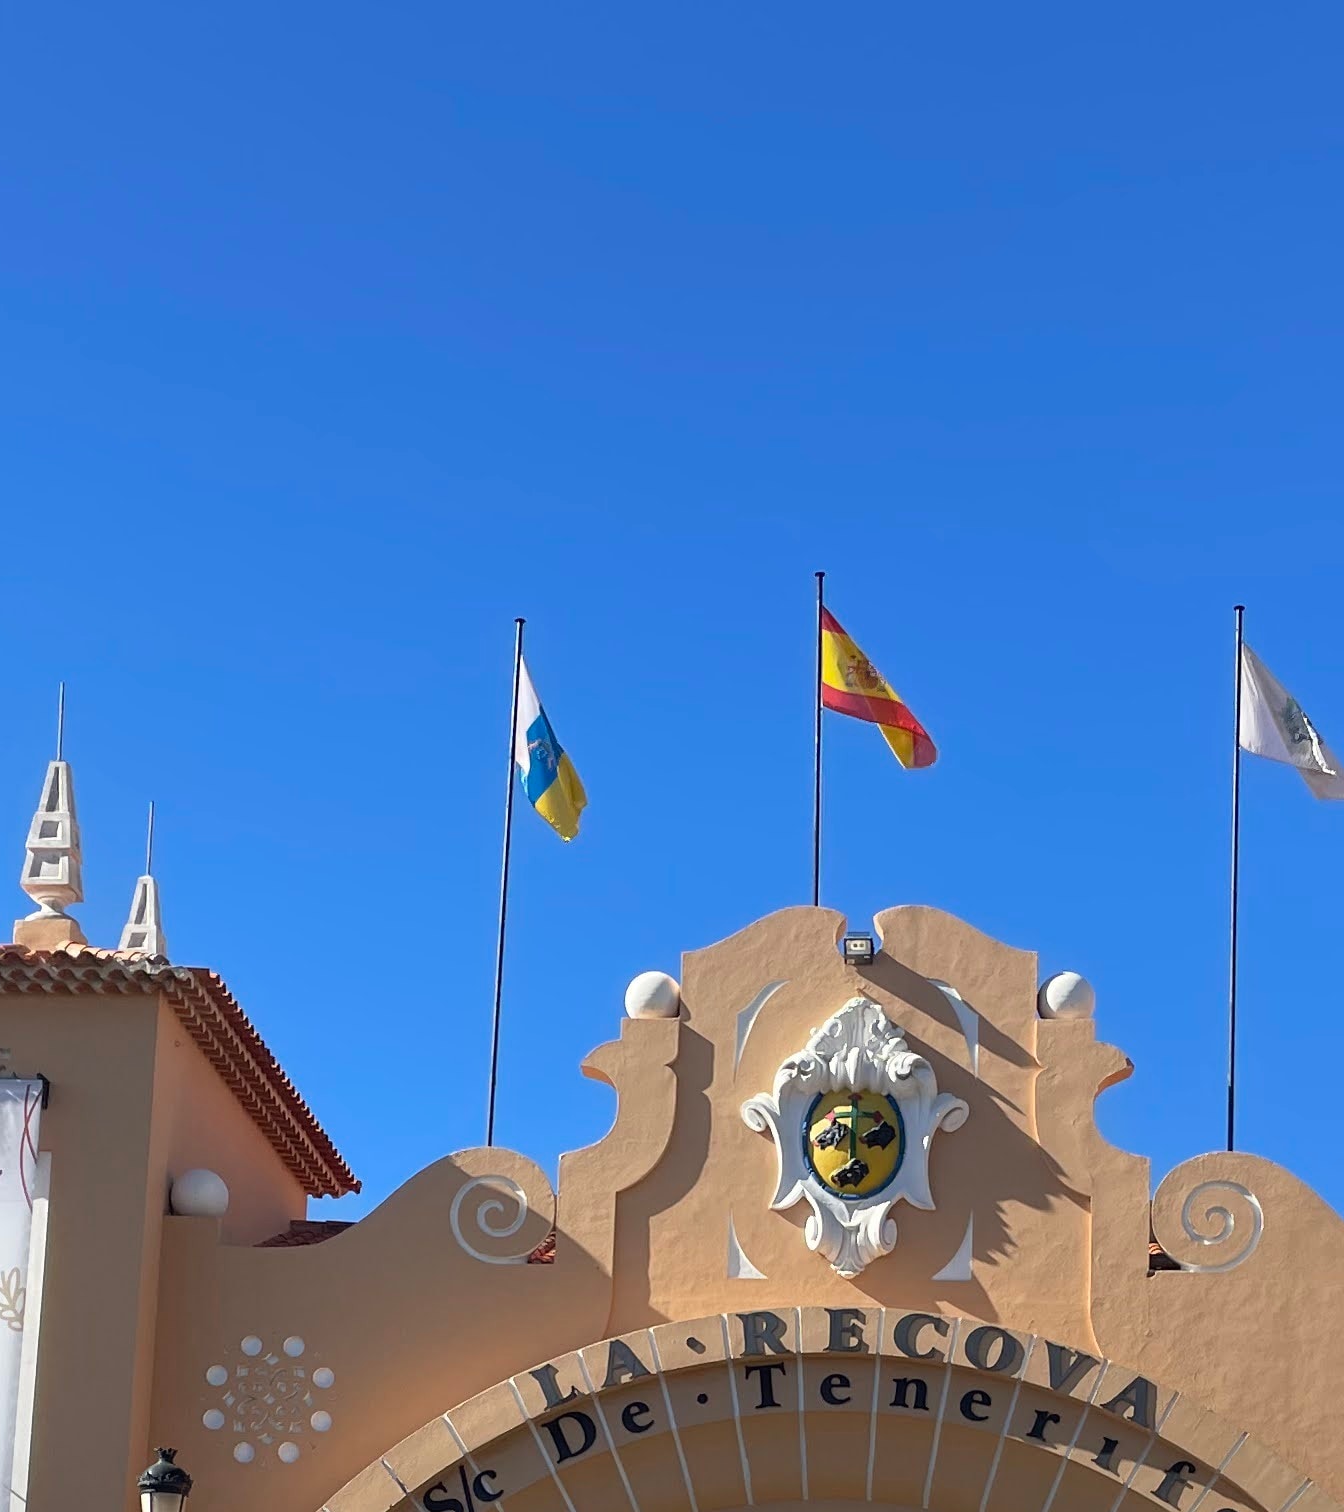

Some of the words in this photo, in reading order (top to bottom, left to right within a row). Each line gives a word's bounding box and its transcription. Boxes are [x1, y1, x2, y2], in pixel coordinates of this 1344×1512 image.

[529, 1338, 653, 1412] LA
[736, 1307, 1158, 1432] RECOVA
[540, 1400, 655, 1464] De
